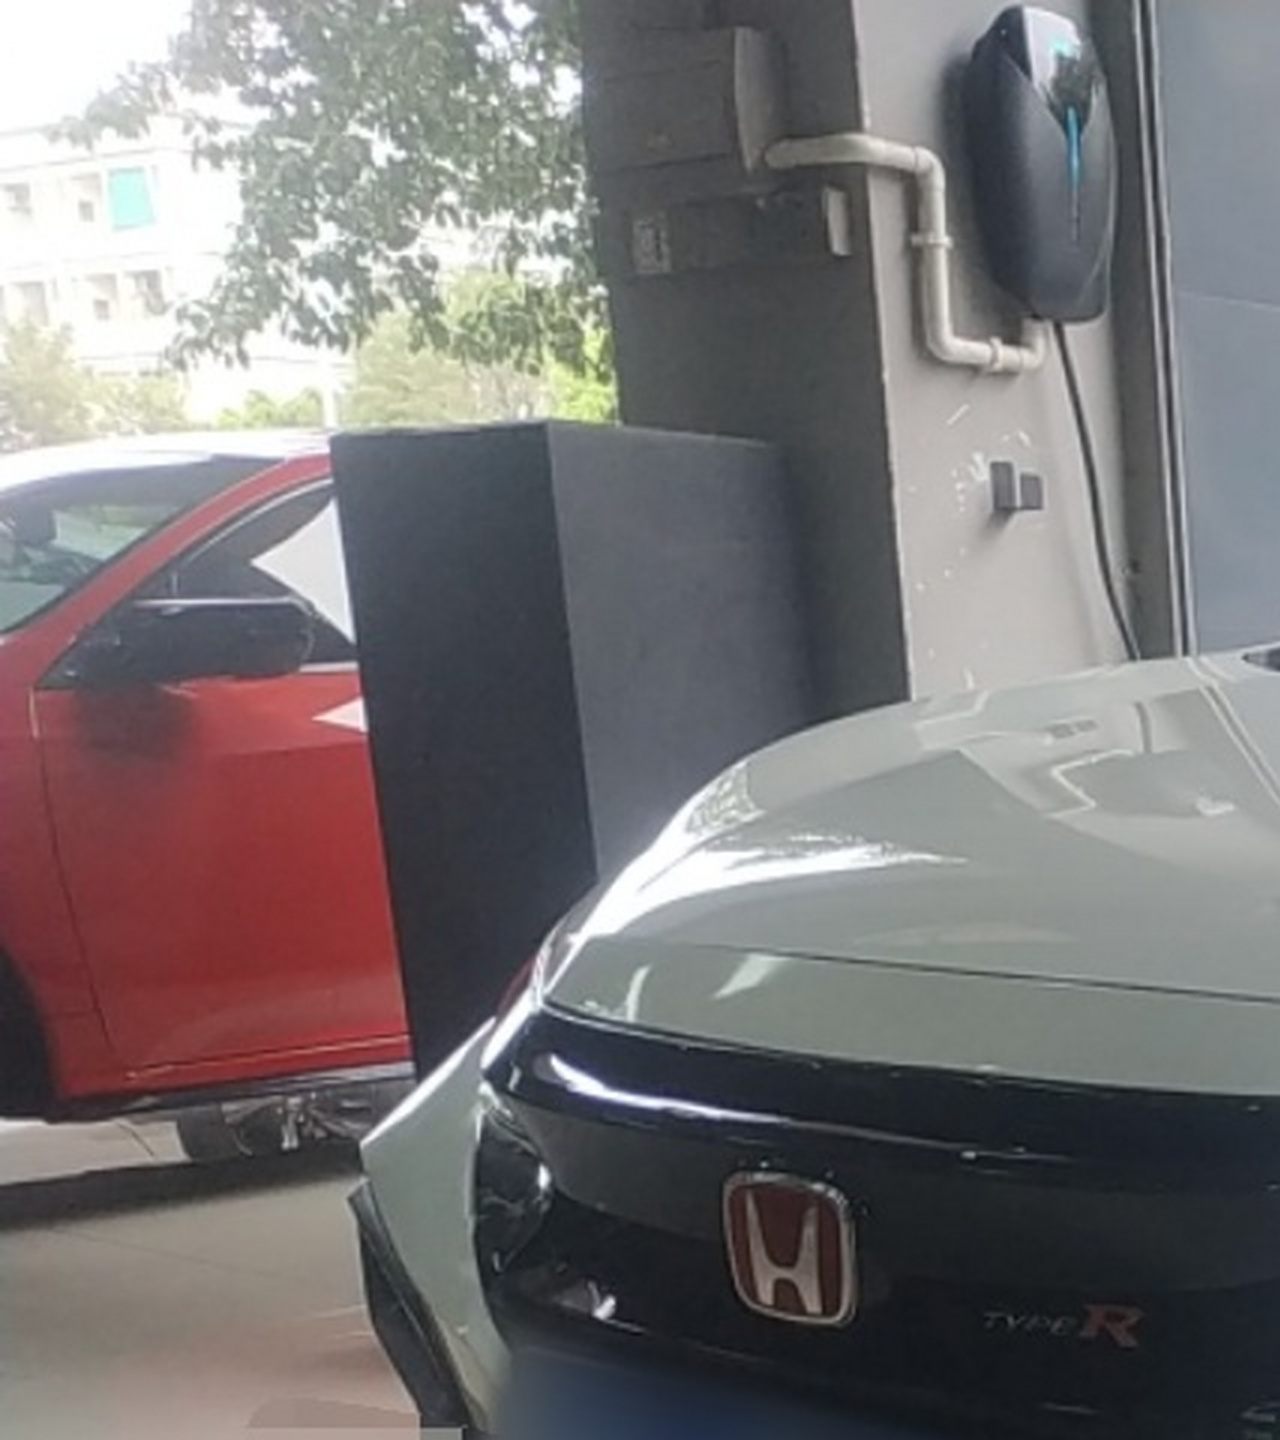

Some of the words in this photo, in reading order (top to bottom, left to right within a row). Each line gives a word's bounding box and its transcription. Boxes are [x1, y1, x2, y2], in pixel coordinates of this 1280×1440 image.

[746, 1190, 823, 1316] H
[982, 1310, 1078, 1336] TYPE
[1078, 1302, 1145, 1348] R
